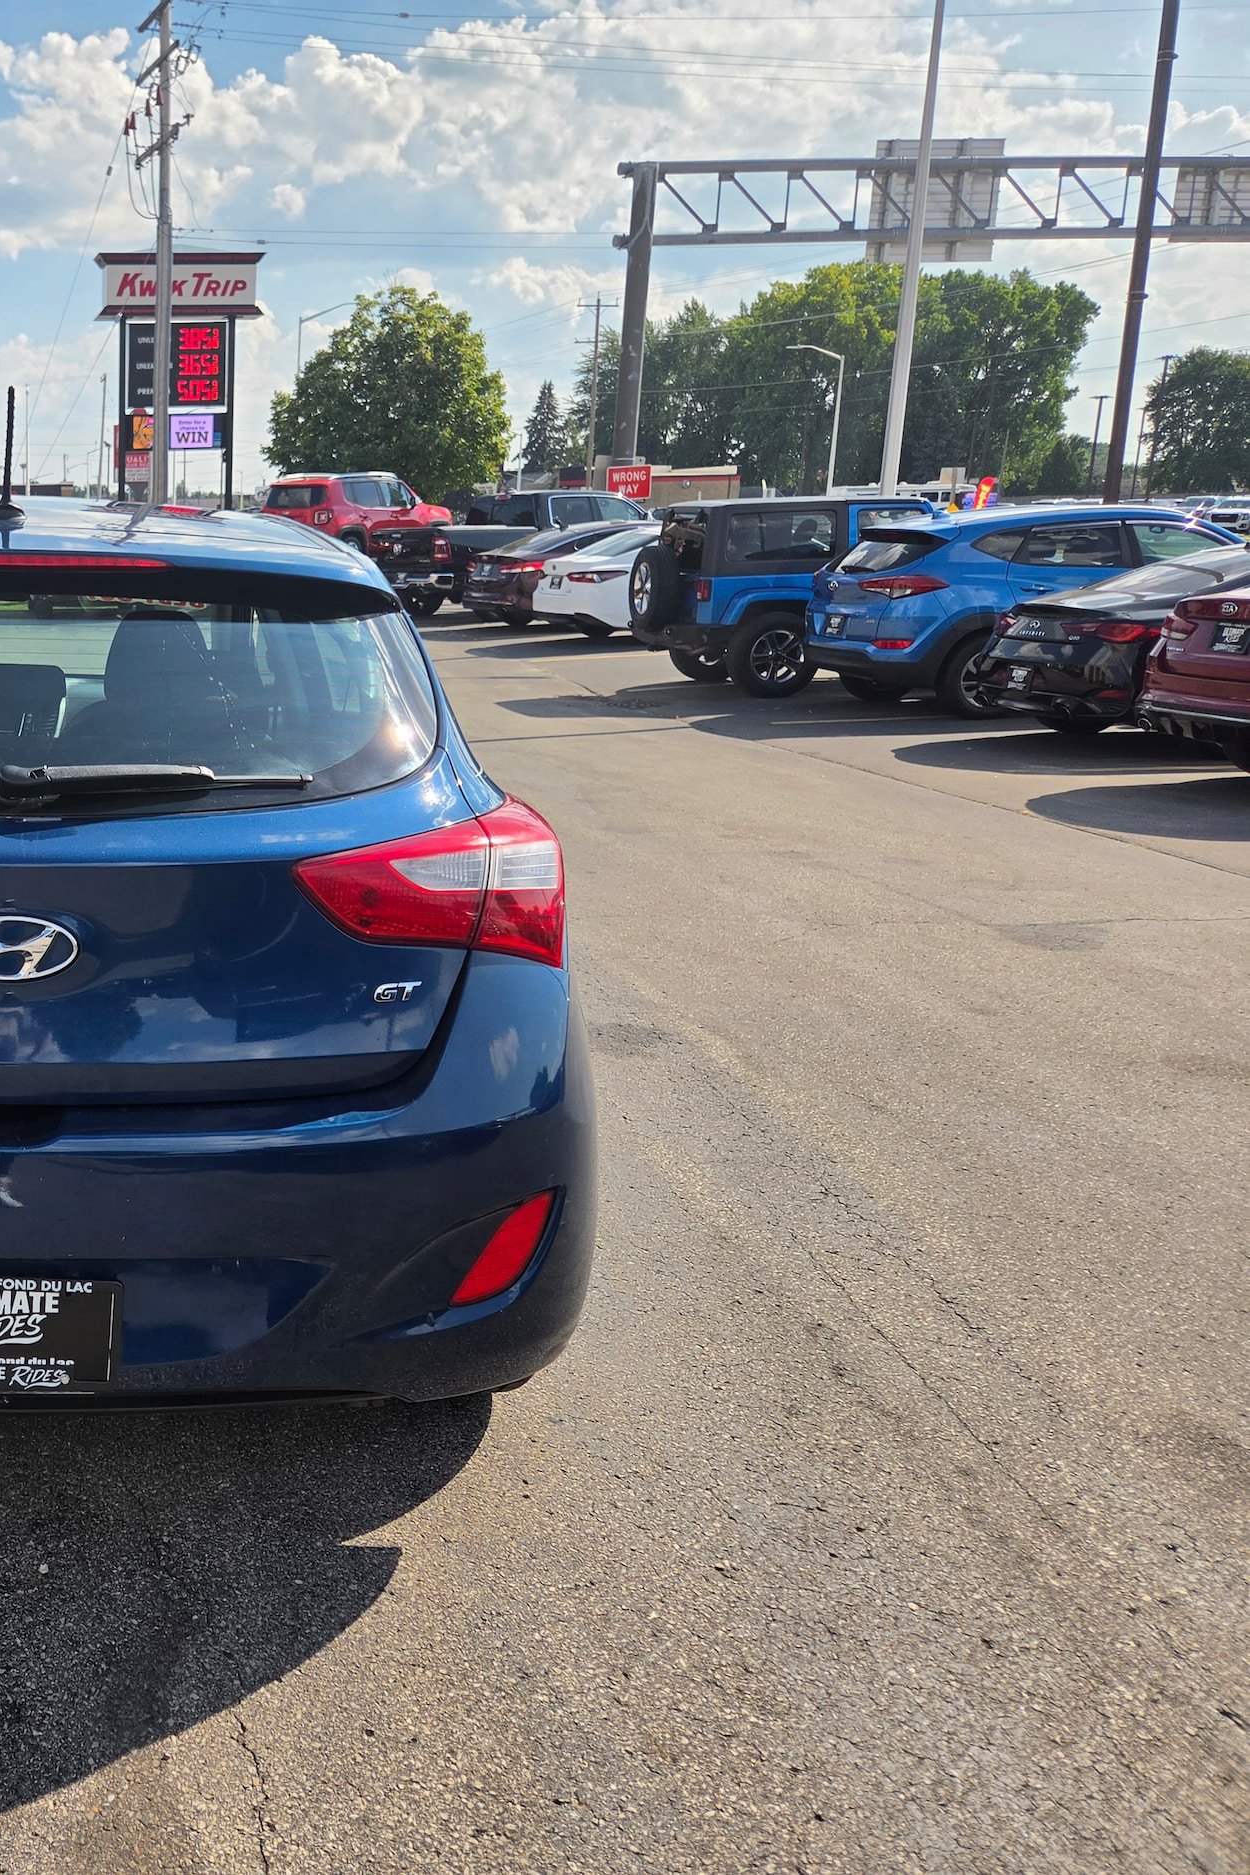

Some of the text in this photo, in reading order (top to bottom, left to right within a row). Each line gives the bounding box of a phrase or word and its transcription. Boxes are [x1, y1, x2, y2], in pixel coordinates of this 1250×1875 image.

[116, 273, 247, 297] KWK TRIP
[175, 431, 208, 443] WIN
[612, 471, 646, 482] WRONG
[618, 484, 639, 494] WAY
[374, 981, 422, 1002] GT
[41, 1281, 62, 1292] DU
[66, 1282, 92, 1293] LAC
